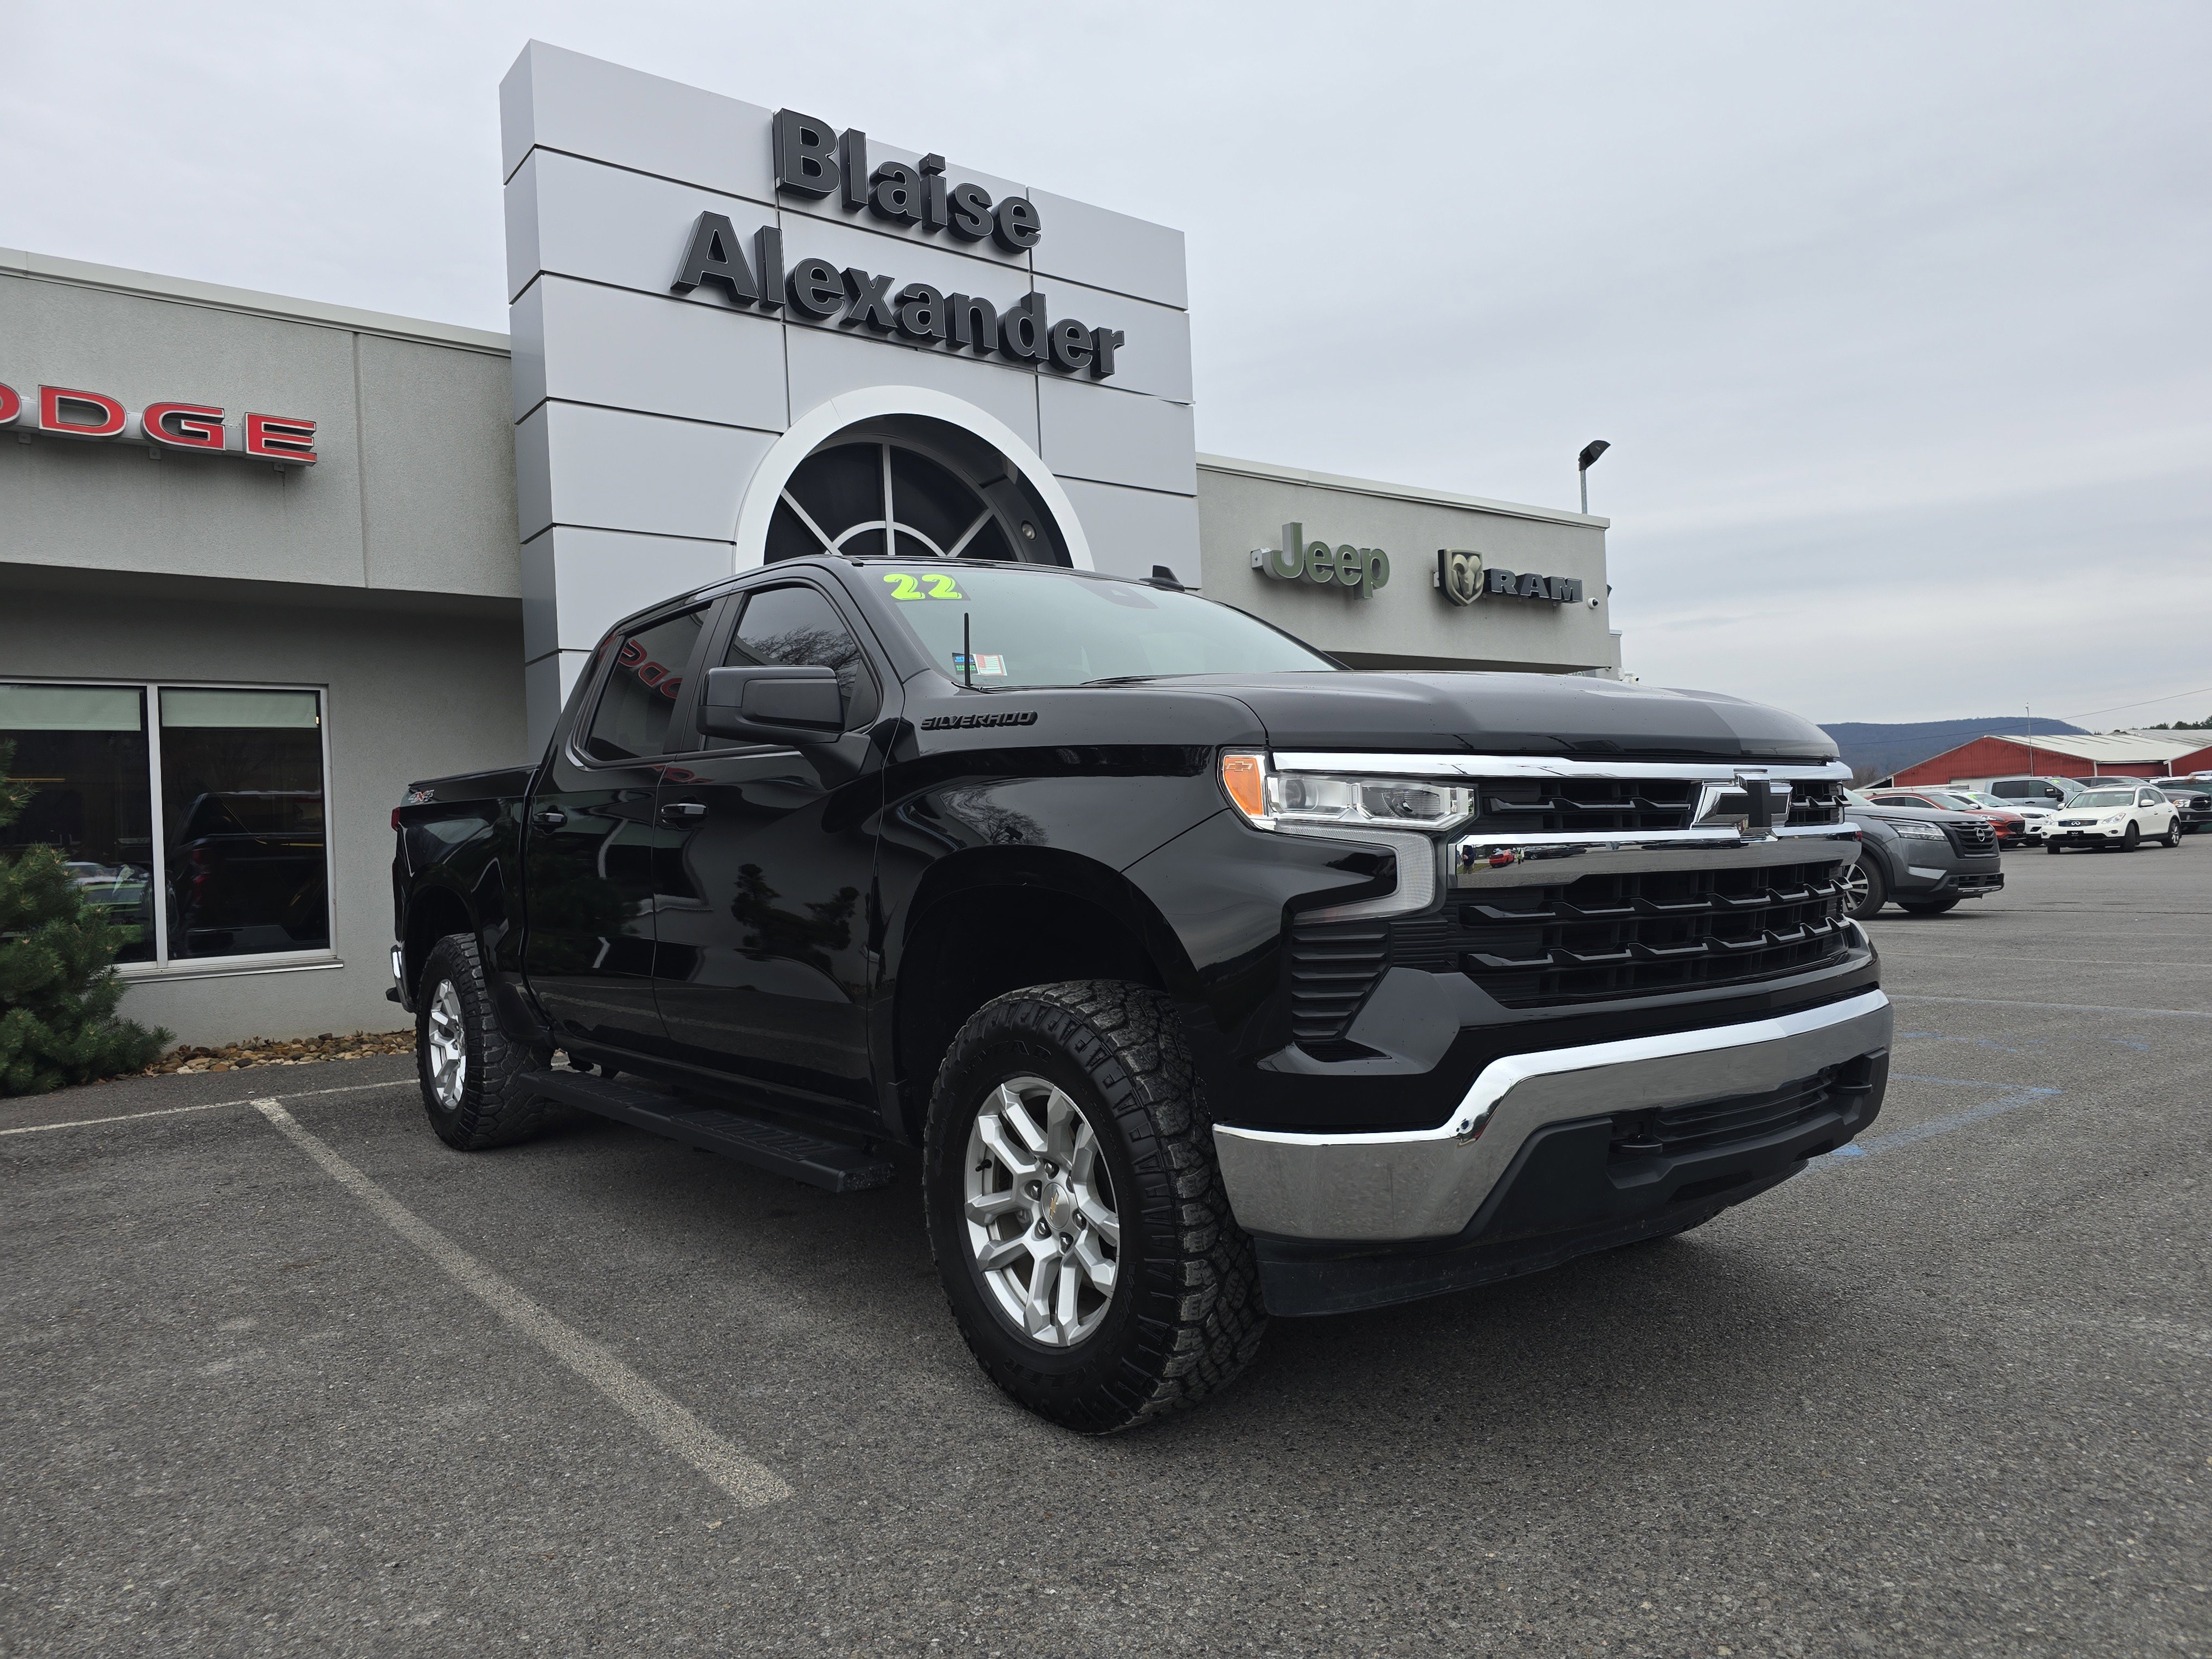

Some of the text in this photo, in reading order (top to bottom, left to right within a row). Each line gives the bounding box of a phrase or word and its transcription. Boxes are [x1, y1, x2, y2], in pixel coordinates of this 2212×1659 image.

[773, 108, 1041, 254] Blaise
[671, 211, 1126, 379] Alexander
[0, 383, 317, 466] DGE
[883, 574, 962, 600] 22
[1262, 522, 1390, 599] Jeep
[1483, 568, 1583, 602] RAM
[921, 710, 1038, 730] SILVERADO
